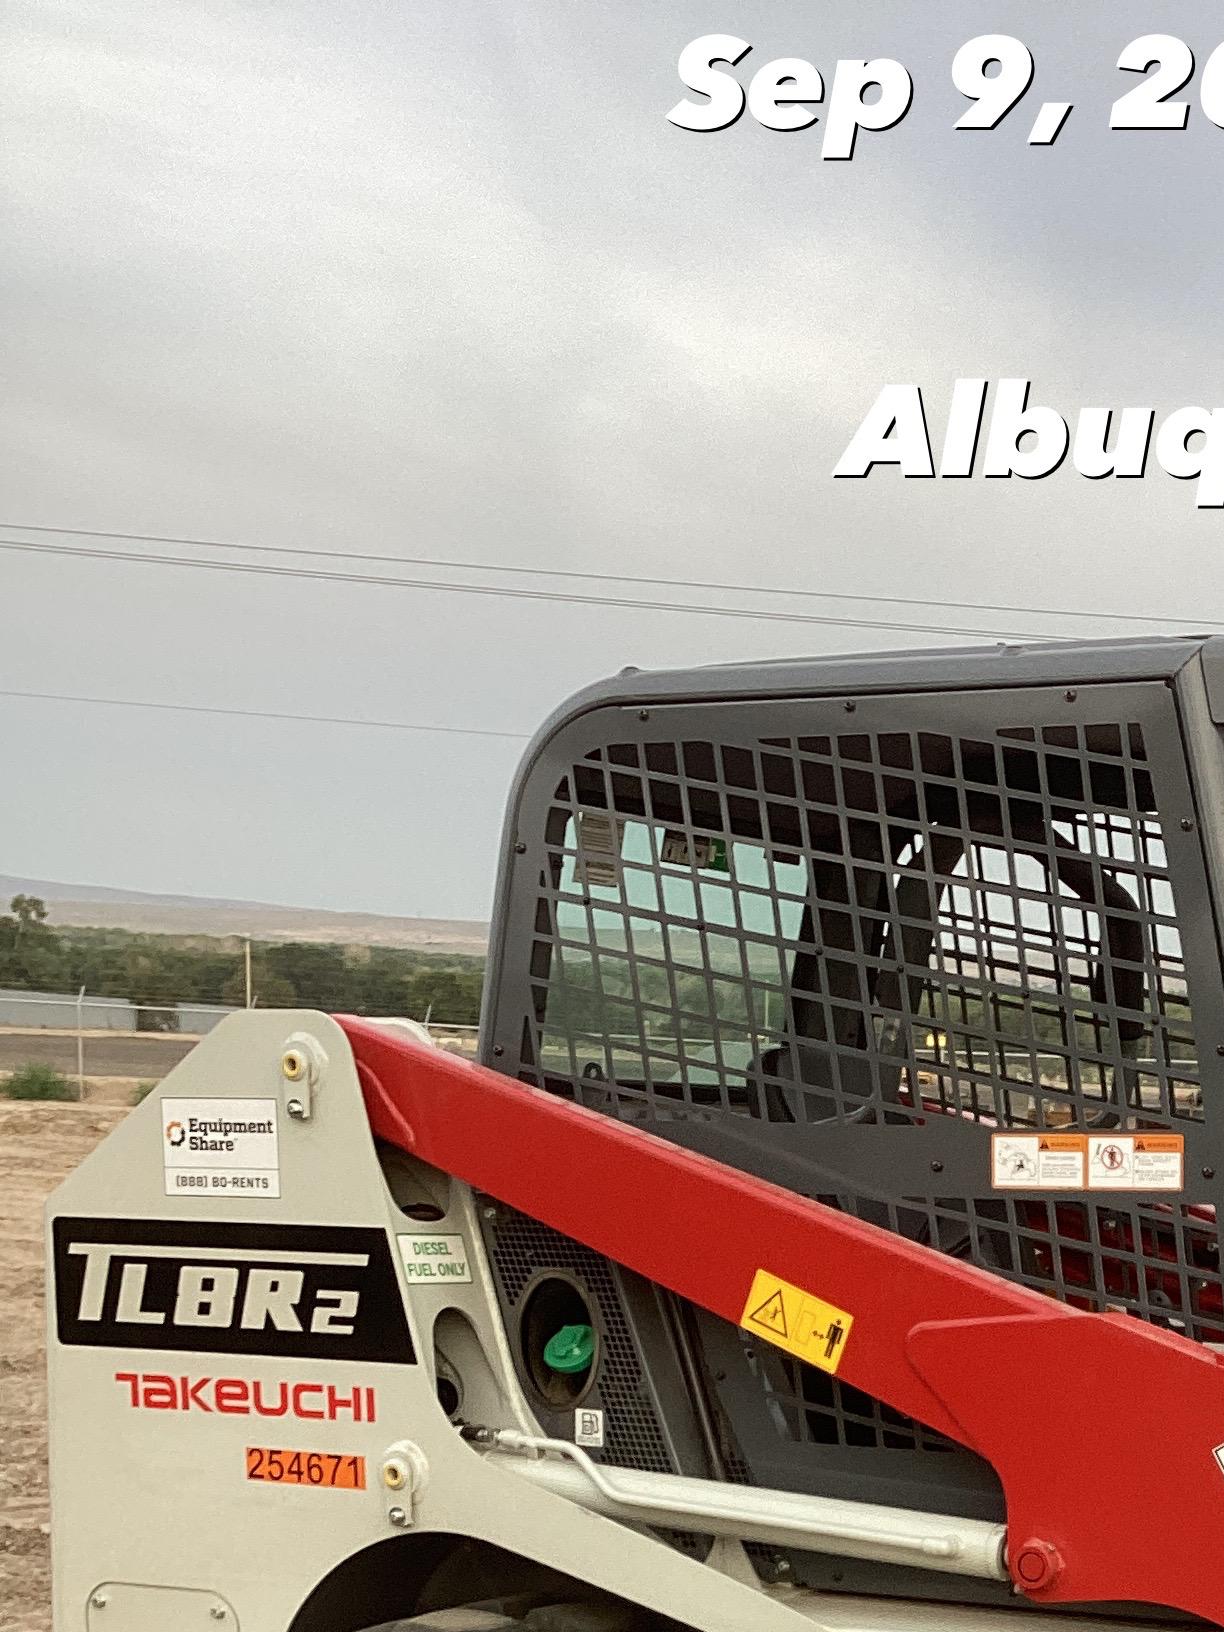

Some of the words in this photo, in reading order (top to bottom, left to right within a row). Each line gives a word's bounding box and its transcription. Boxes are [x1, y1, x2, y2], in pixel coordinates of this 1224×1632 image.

[188, 1117, 274, 1137] Equipment
[189, 1136, 235, 1152] Share
[412, 1241, 453, 1256] DIESEL
[406, 1262, 437, 1277] FUEL
[437, 1262, 466, 1276] ONLY
[67, 1242, 370, 1335] TL8R2
[114, 1372, 377, 1423] TAKEUCHI
[248, 1448, 359, 1487] 254671
